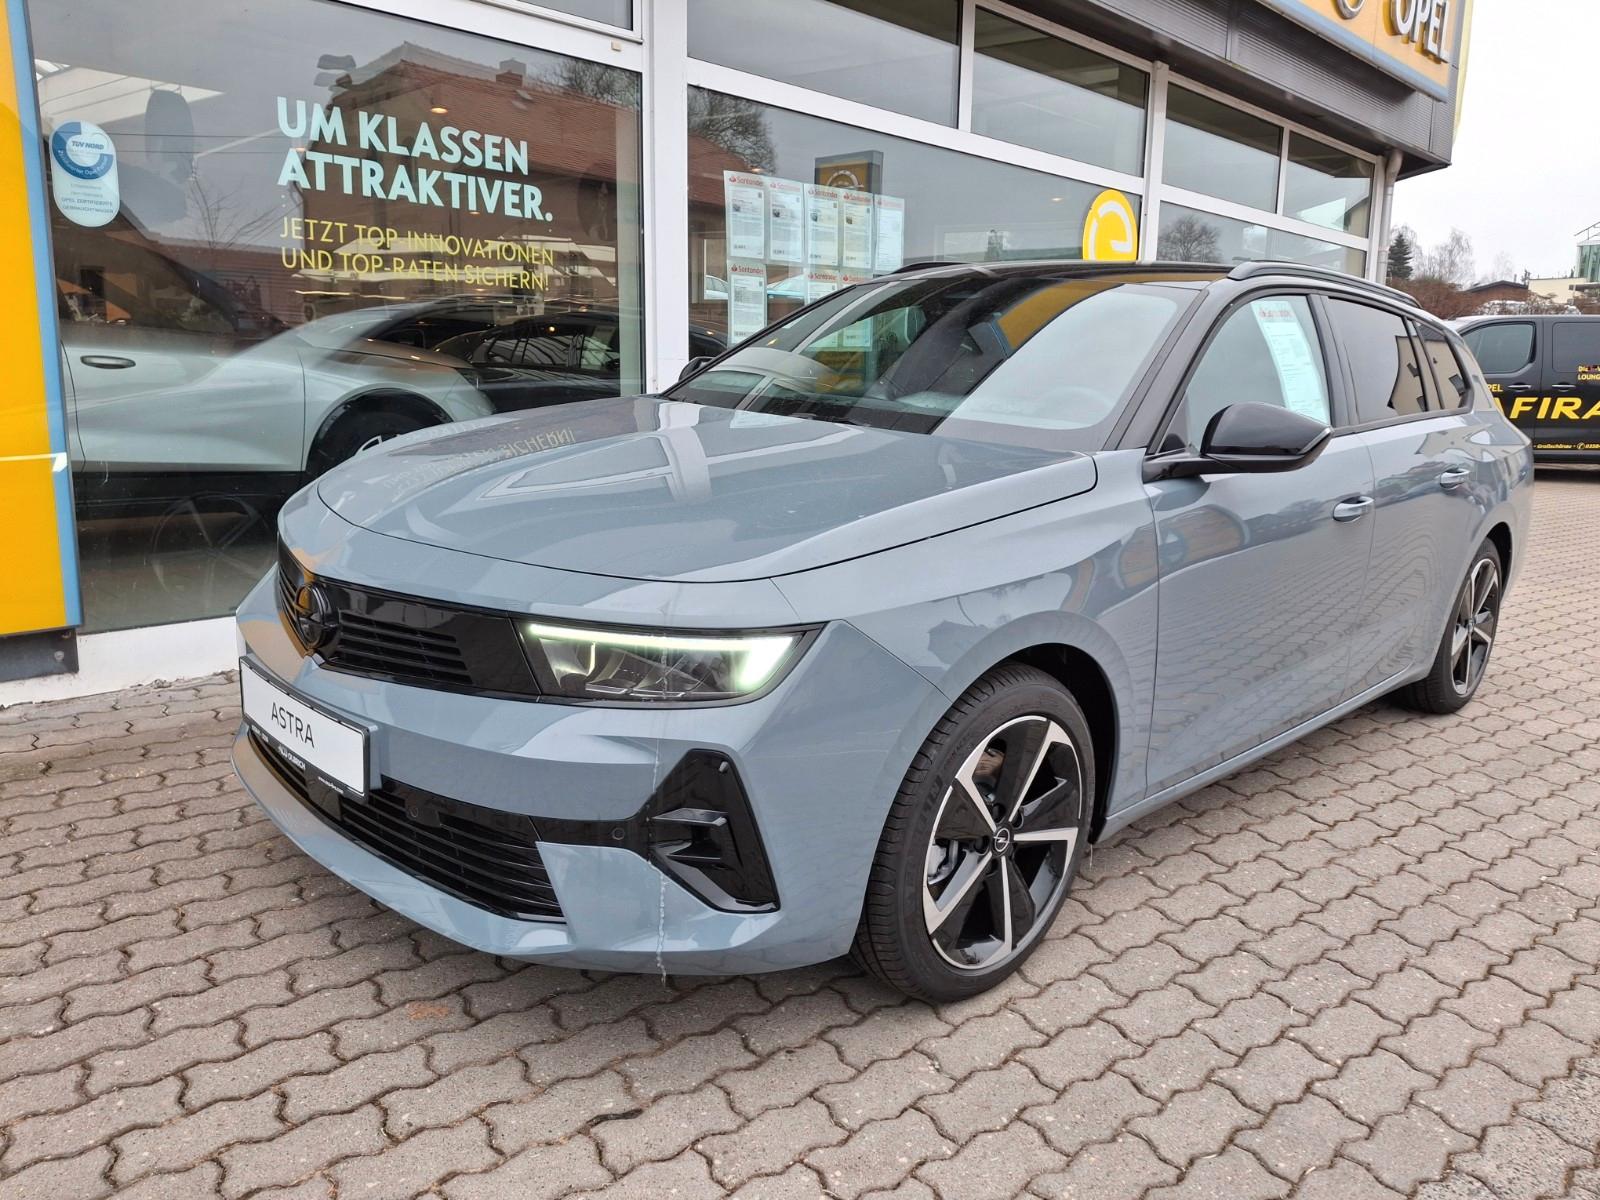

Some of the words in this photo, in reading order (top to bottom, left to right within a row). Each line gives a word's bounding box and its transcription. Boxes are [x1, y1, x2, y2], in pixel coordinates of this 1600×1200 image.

[1393, 0, 1450, 63] OPEL
[71, 140, 84, 149] TÜV
[84, 141, 105, 150] NORD
[277, 96, 347, 146] UM
[358, 111, 529, 176] KLASSEN
[277, 148, 554, 222] ATTRAKTIVER.
[280, 216, 348, 244] JETZT
[281, 247, 333, 272] UND
[339, 252, 458, 282] TOP-RATEN
[463, 264, 549, 291] SICHERN!
[1487, 383, 1503, 392] PEL
[271, 701, 315, 748] ASTRA
